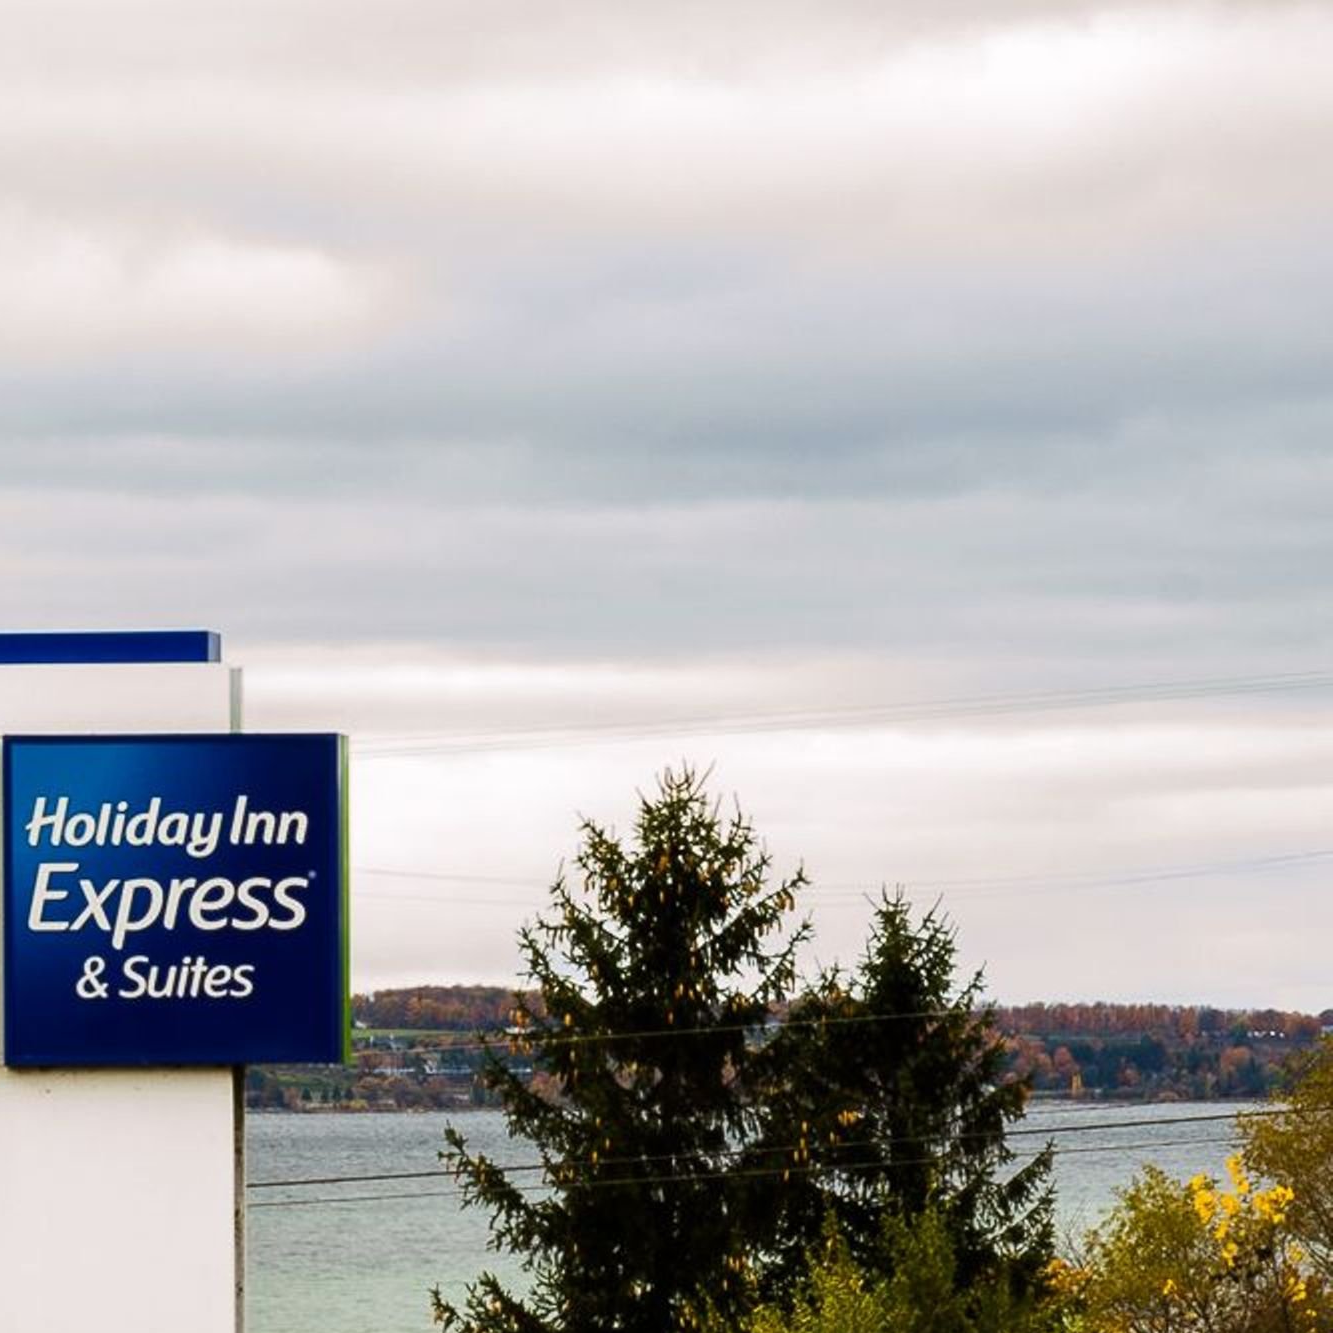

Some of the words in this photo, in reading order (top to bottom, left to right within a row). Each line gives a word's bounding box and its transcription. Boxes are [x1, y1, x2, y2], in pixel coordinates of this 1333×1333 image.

[25, 796, 223, 857] Holiday
[229, 795, 308, 845] Inn
[28, 862, 308, 950] Express
[76, 956, 109, 999] &
[118, 955, 255, 999] Suites
